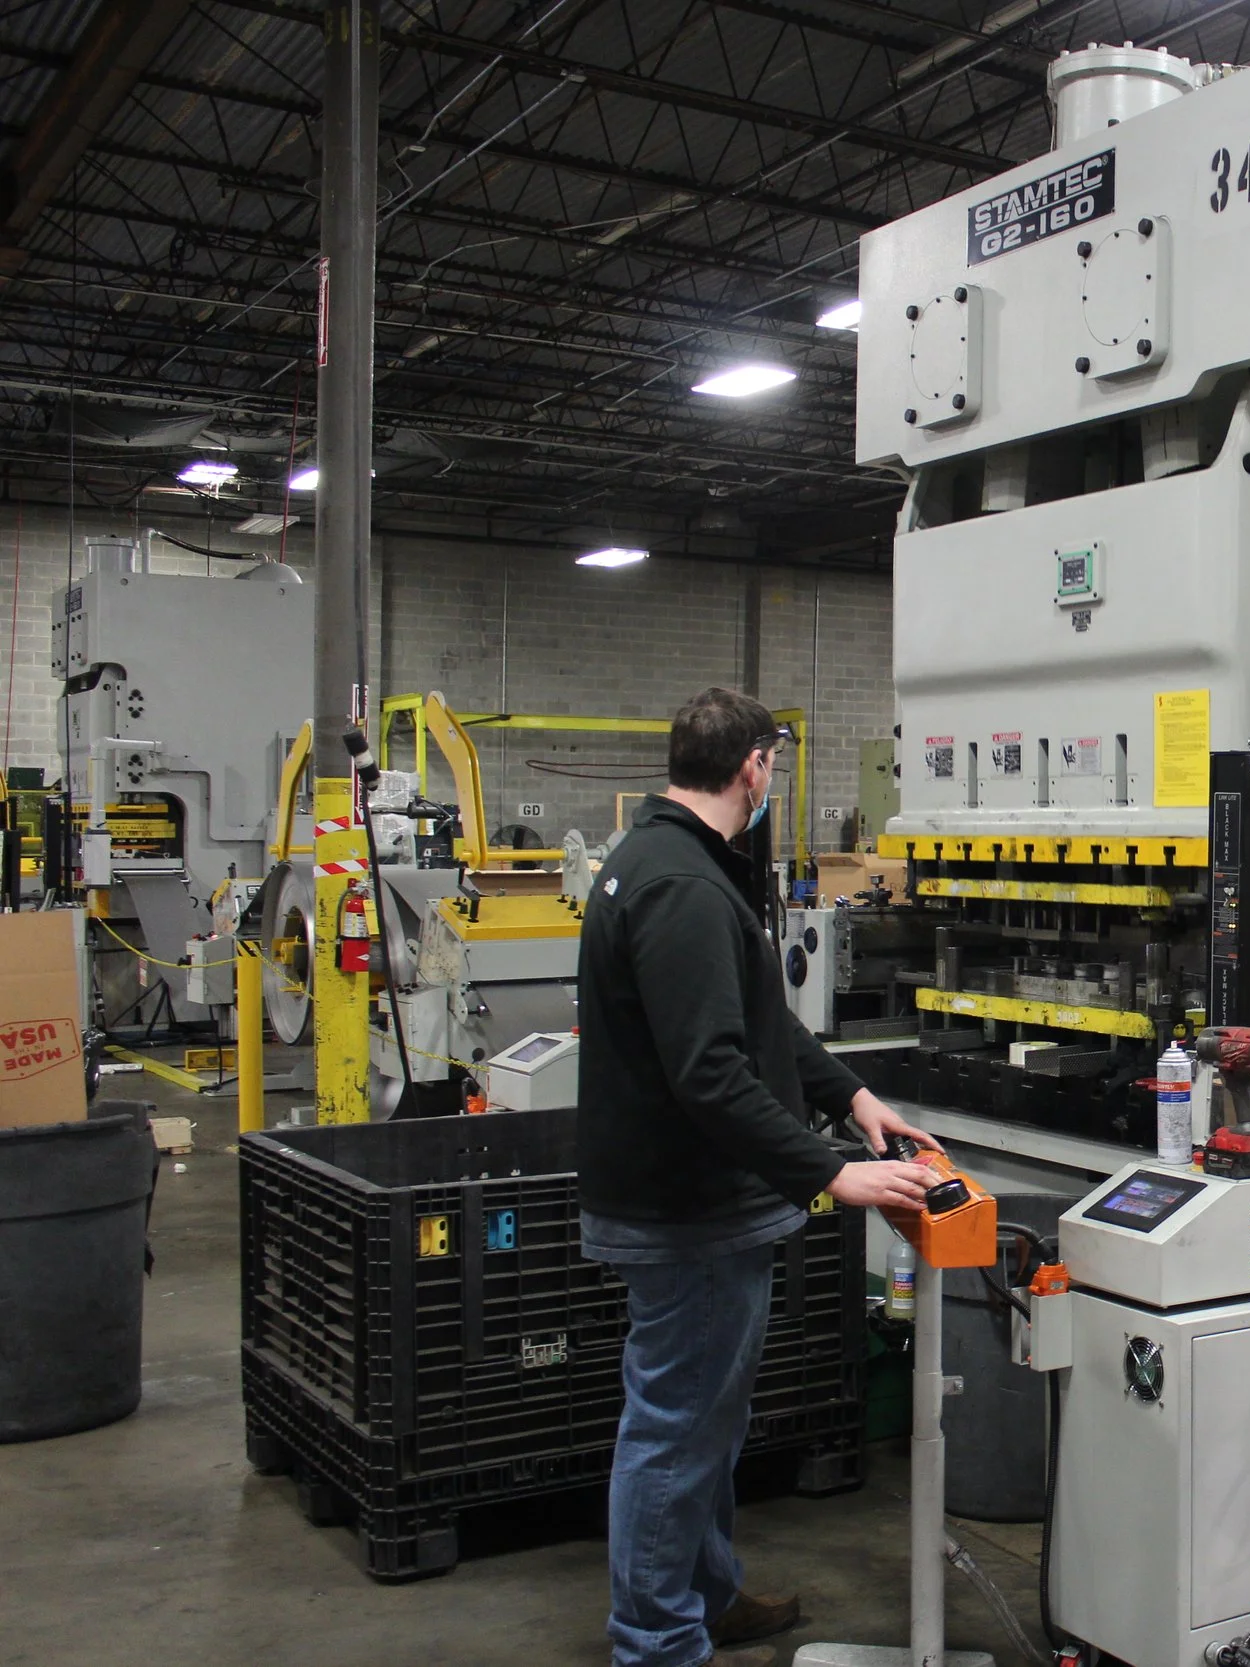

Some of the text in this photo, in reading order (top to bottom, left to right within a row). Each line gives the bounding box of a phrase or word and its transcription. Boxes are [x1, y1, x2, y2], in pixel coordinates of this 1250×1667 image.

[974, 156, 1103, 232] STAMTEC
[981, 194, 1095, 257] G2-160
[523, 804, 540, 816] GD
[824, 809, 839, 819] GC
[0, 1023, 57, 1050] USA
[4, 1047, 62, 1071] MADE
